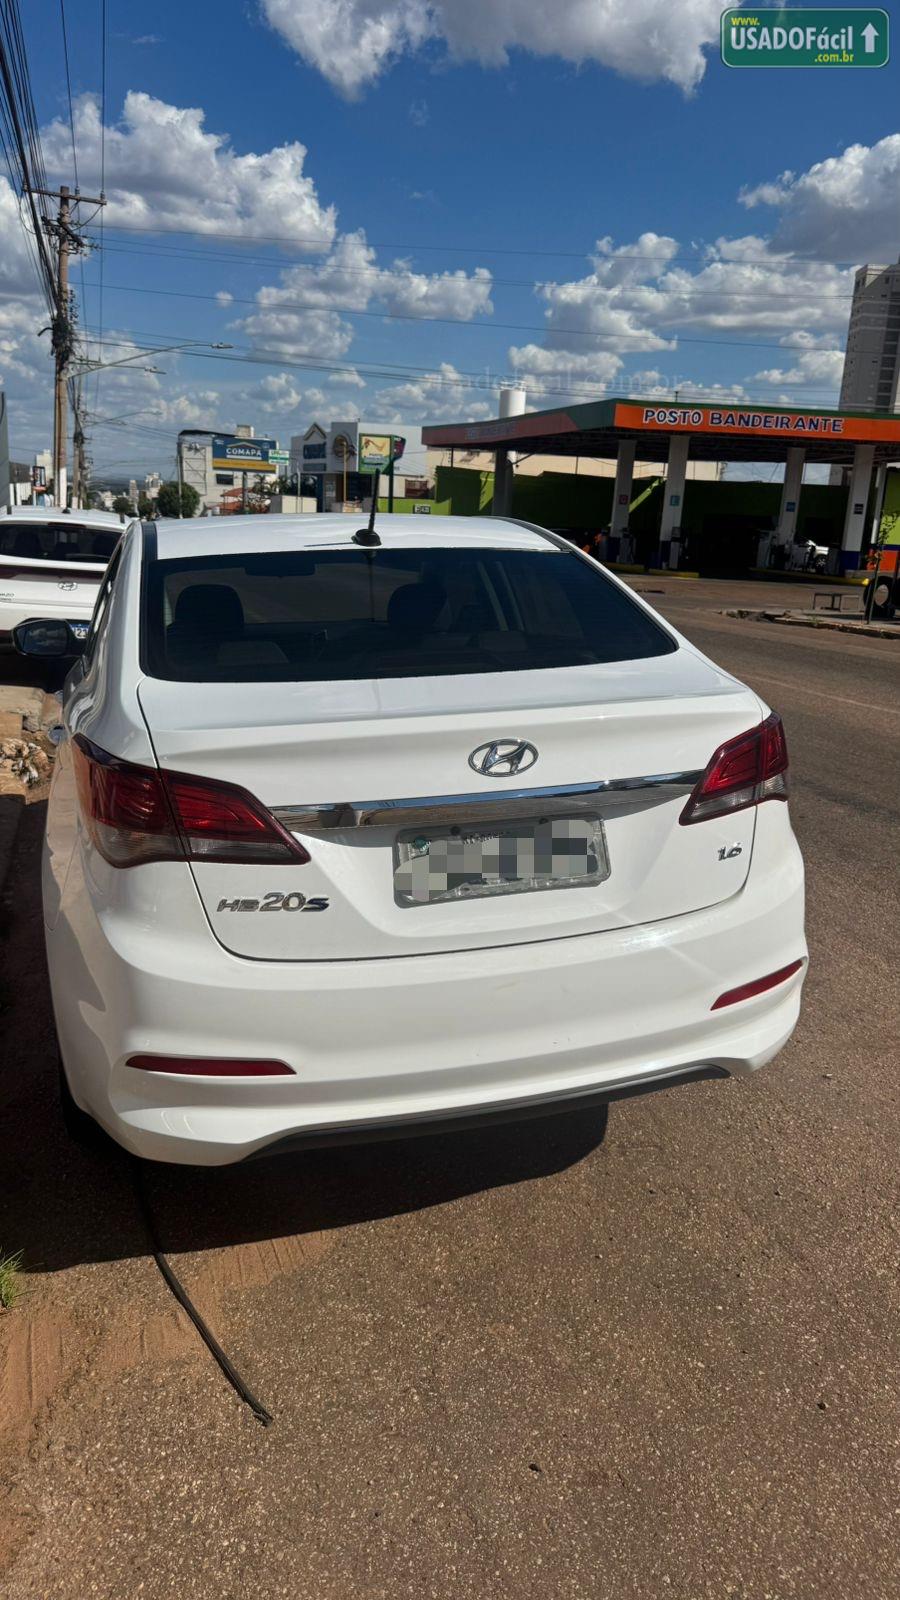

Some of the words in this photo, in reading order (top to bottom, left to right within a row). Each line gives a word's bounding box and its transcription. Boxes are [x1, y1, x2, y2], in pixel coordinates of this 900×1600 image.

[643, 408, 703, 425] POSTO
[709, 411, 844, 433] BANDEIRANTE
[226, 448, 262, 456] COMAPA
[216, 892, 330, 912] HB20S
